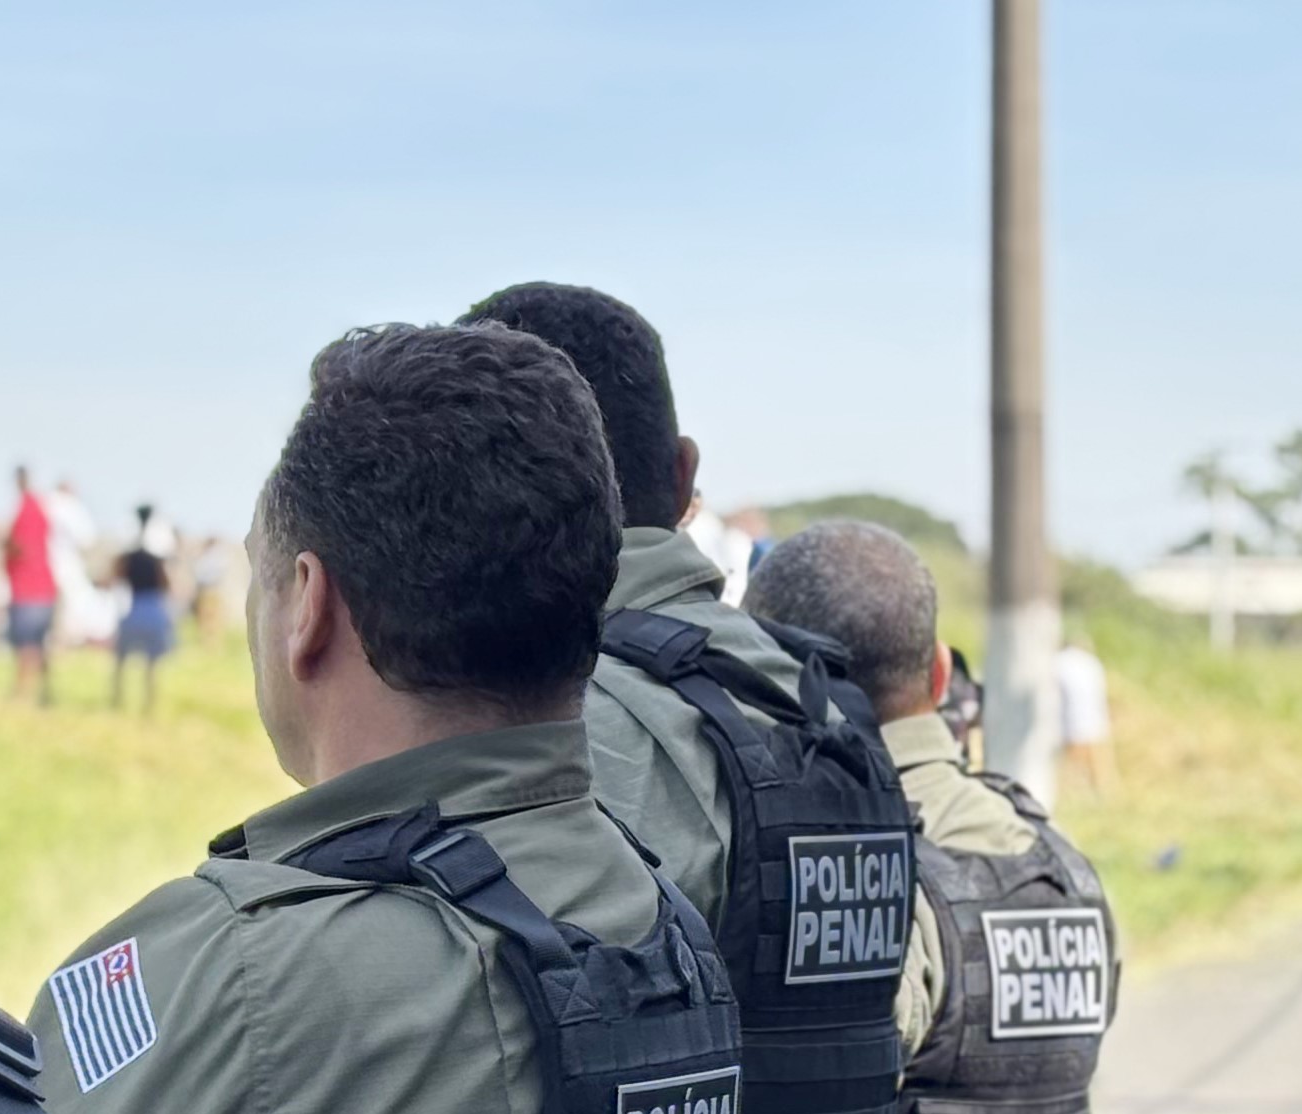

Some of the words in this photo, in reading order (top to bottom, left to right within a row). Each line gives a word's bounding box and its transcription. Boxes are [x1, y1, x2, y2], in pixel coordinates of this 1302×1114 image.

[798, 843, 905, 904] POLÍCIA
[794, 906, 903, 967] PENAL
[993, 918, 1101, 969] POLÍCIA
[999, 970, 1102, 1023] PENAL
